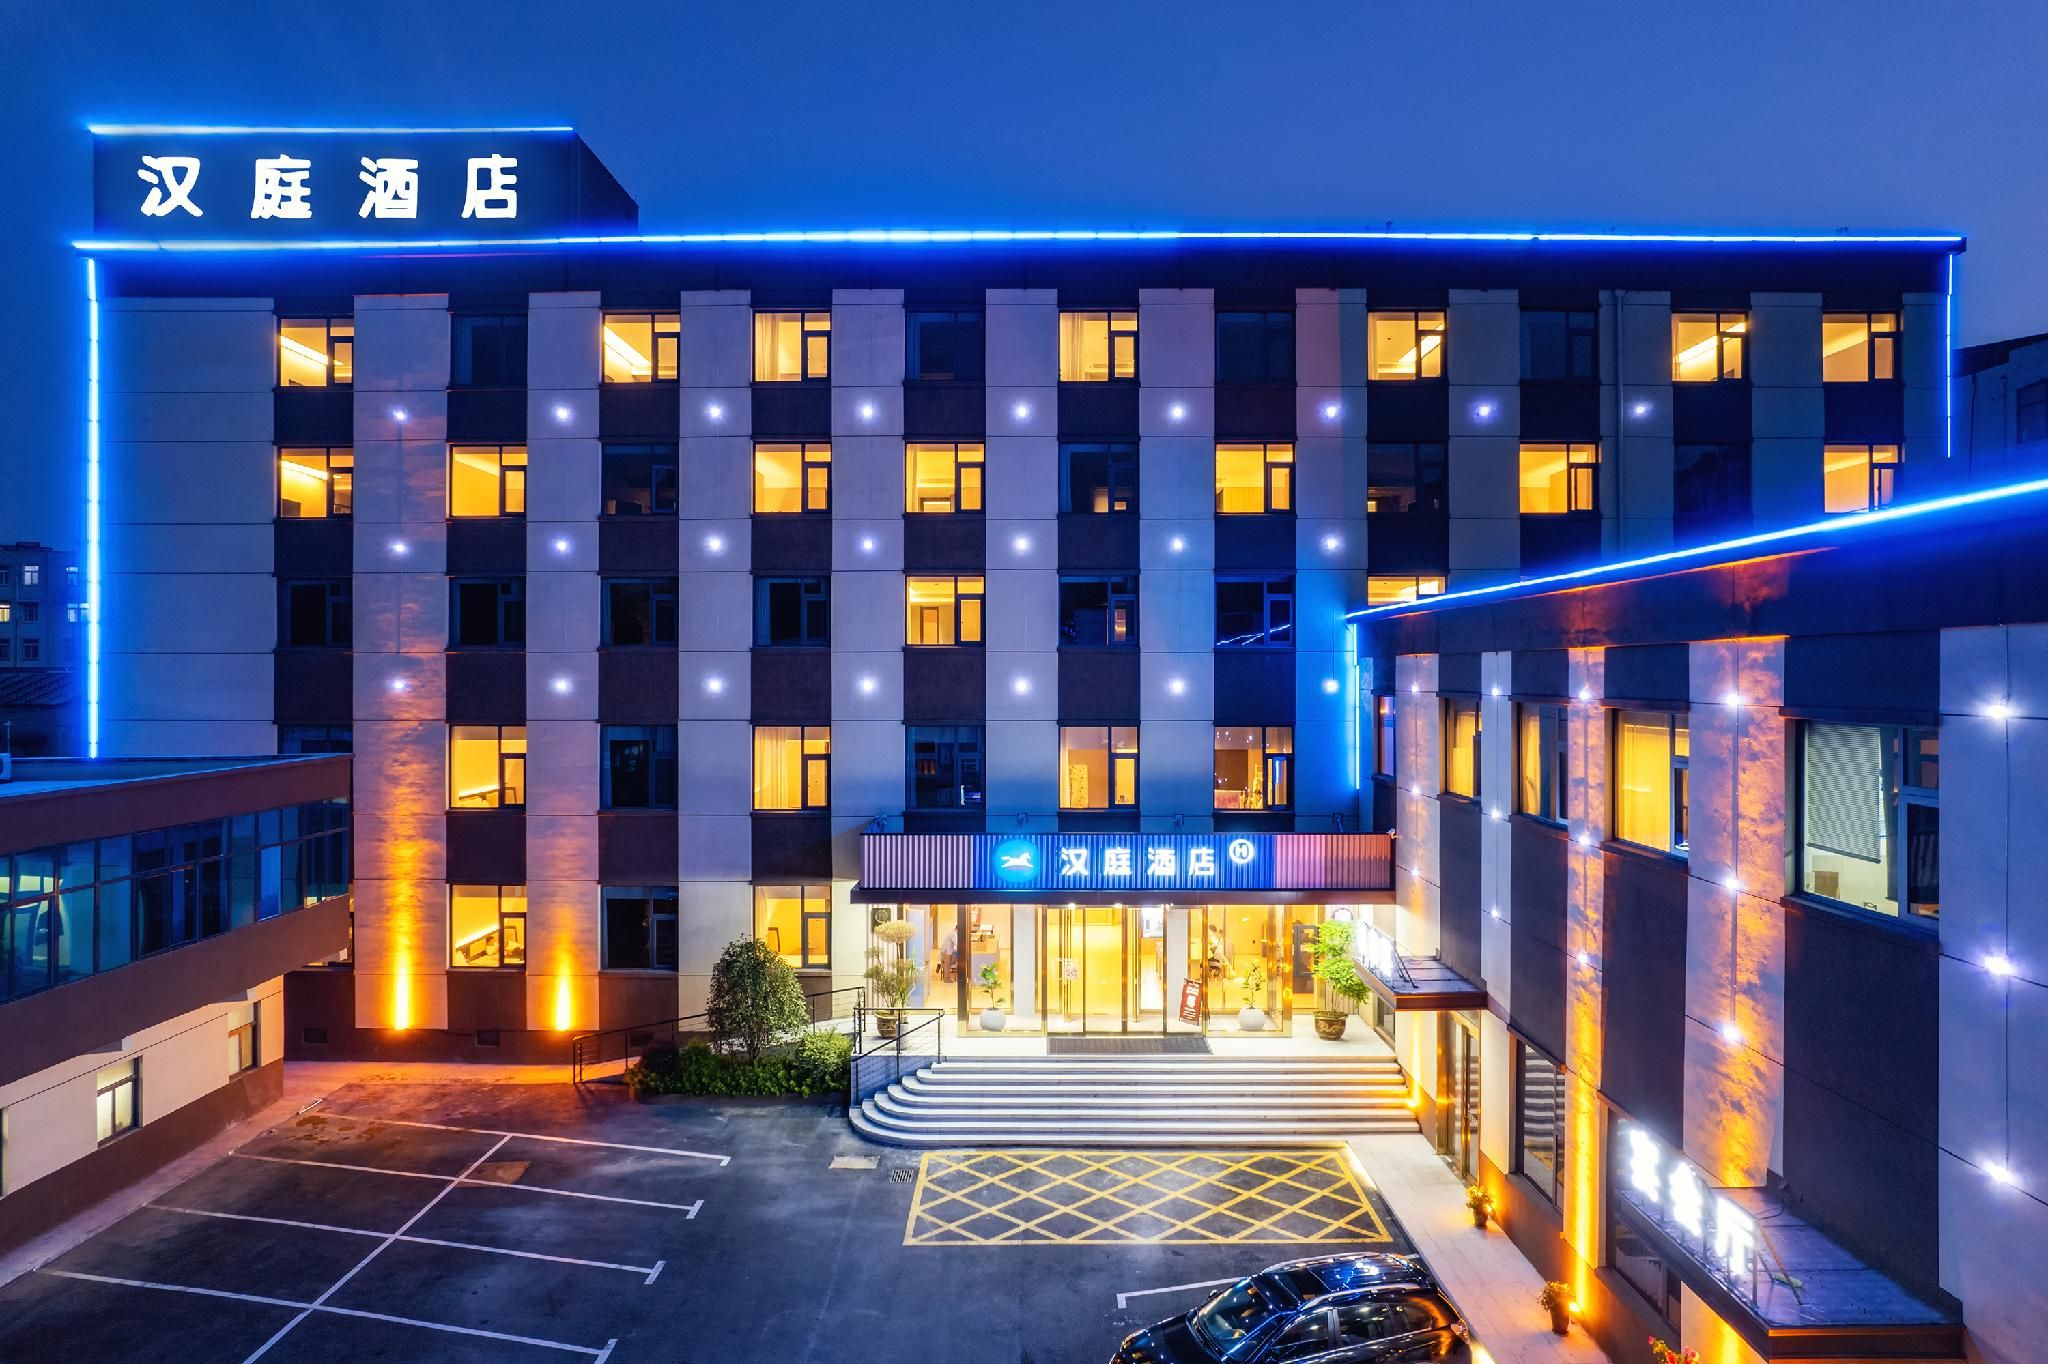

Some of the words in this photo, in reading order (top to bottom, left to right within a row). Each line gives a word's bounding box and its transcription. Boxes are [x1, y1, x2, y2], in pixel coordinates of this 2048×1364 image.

[138, 154, 518, 219] 汉庭酒店
[1061, 846, 1215, 877] 汉庭酒店
